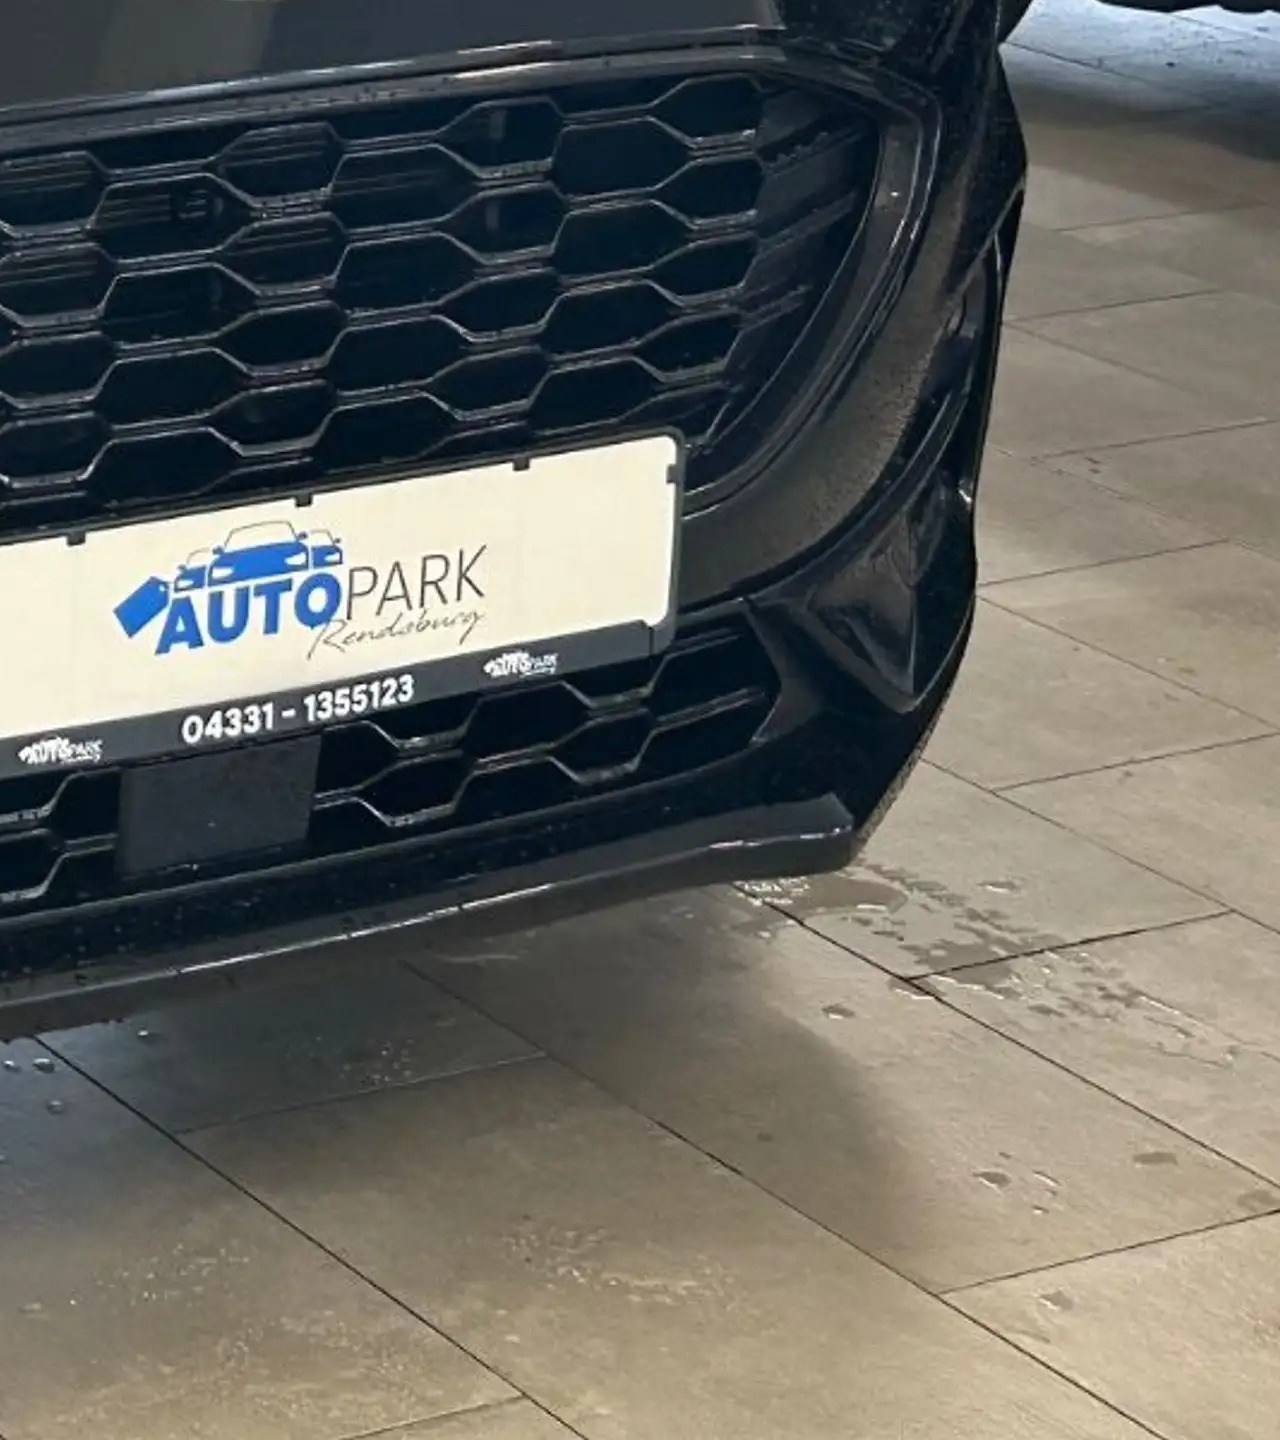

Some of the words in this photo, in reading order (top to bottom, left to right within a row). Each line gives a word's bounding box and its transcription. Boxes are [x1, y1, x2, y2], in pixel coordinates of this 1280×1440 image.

[306, 608, 485, 661] Rendsburg
[181, 701, 275, 745] 04331
[303, 673, 415, 723] 1355123
